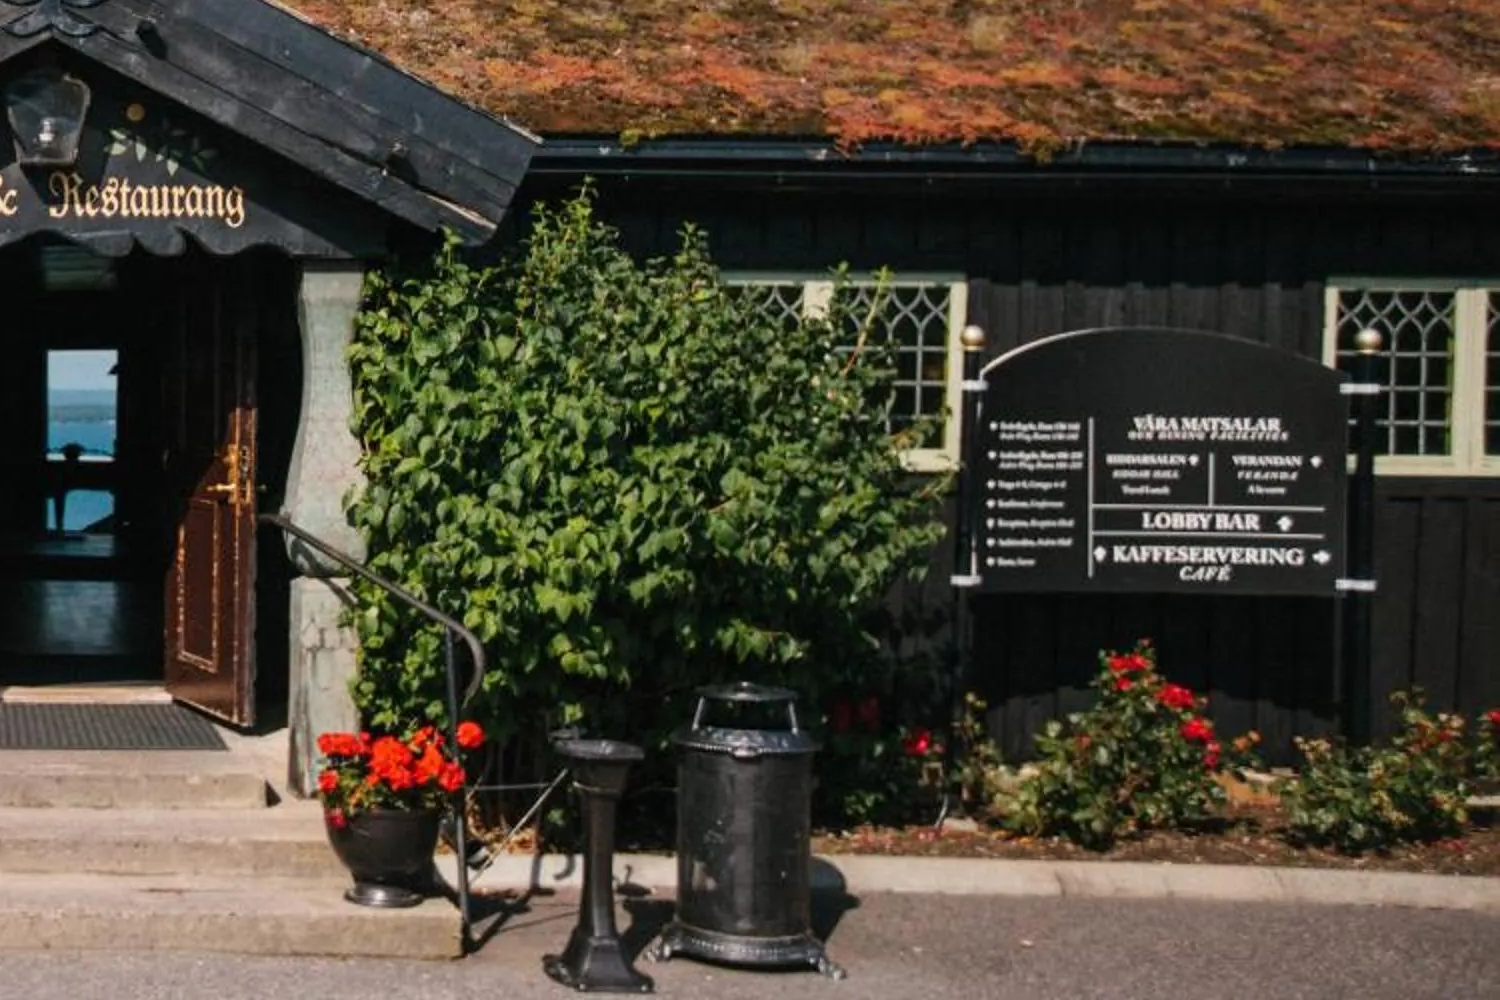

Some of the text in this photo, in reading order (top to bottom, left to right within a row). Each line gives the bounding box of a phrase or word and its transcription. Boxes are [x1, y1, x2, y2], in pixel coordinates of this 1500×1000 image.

[49, 172, 245, 228] Restaurang
[1133, 414, 1281, 432] VÅRA MATSALAR
[1142, 512, 1260, 531] LOBBY BAR
[1113, 545, 1305, 566] KAFFESERVERING
[1179, 564, 1232, 581] CAFÉ
